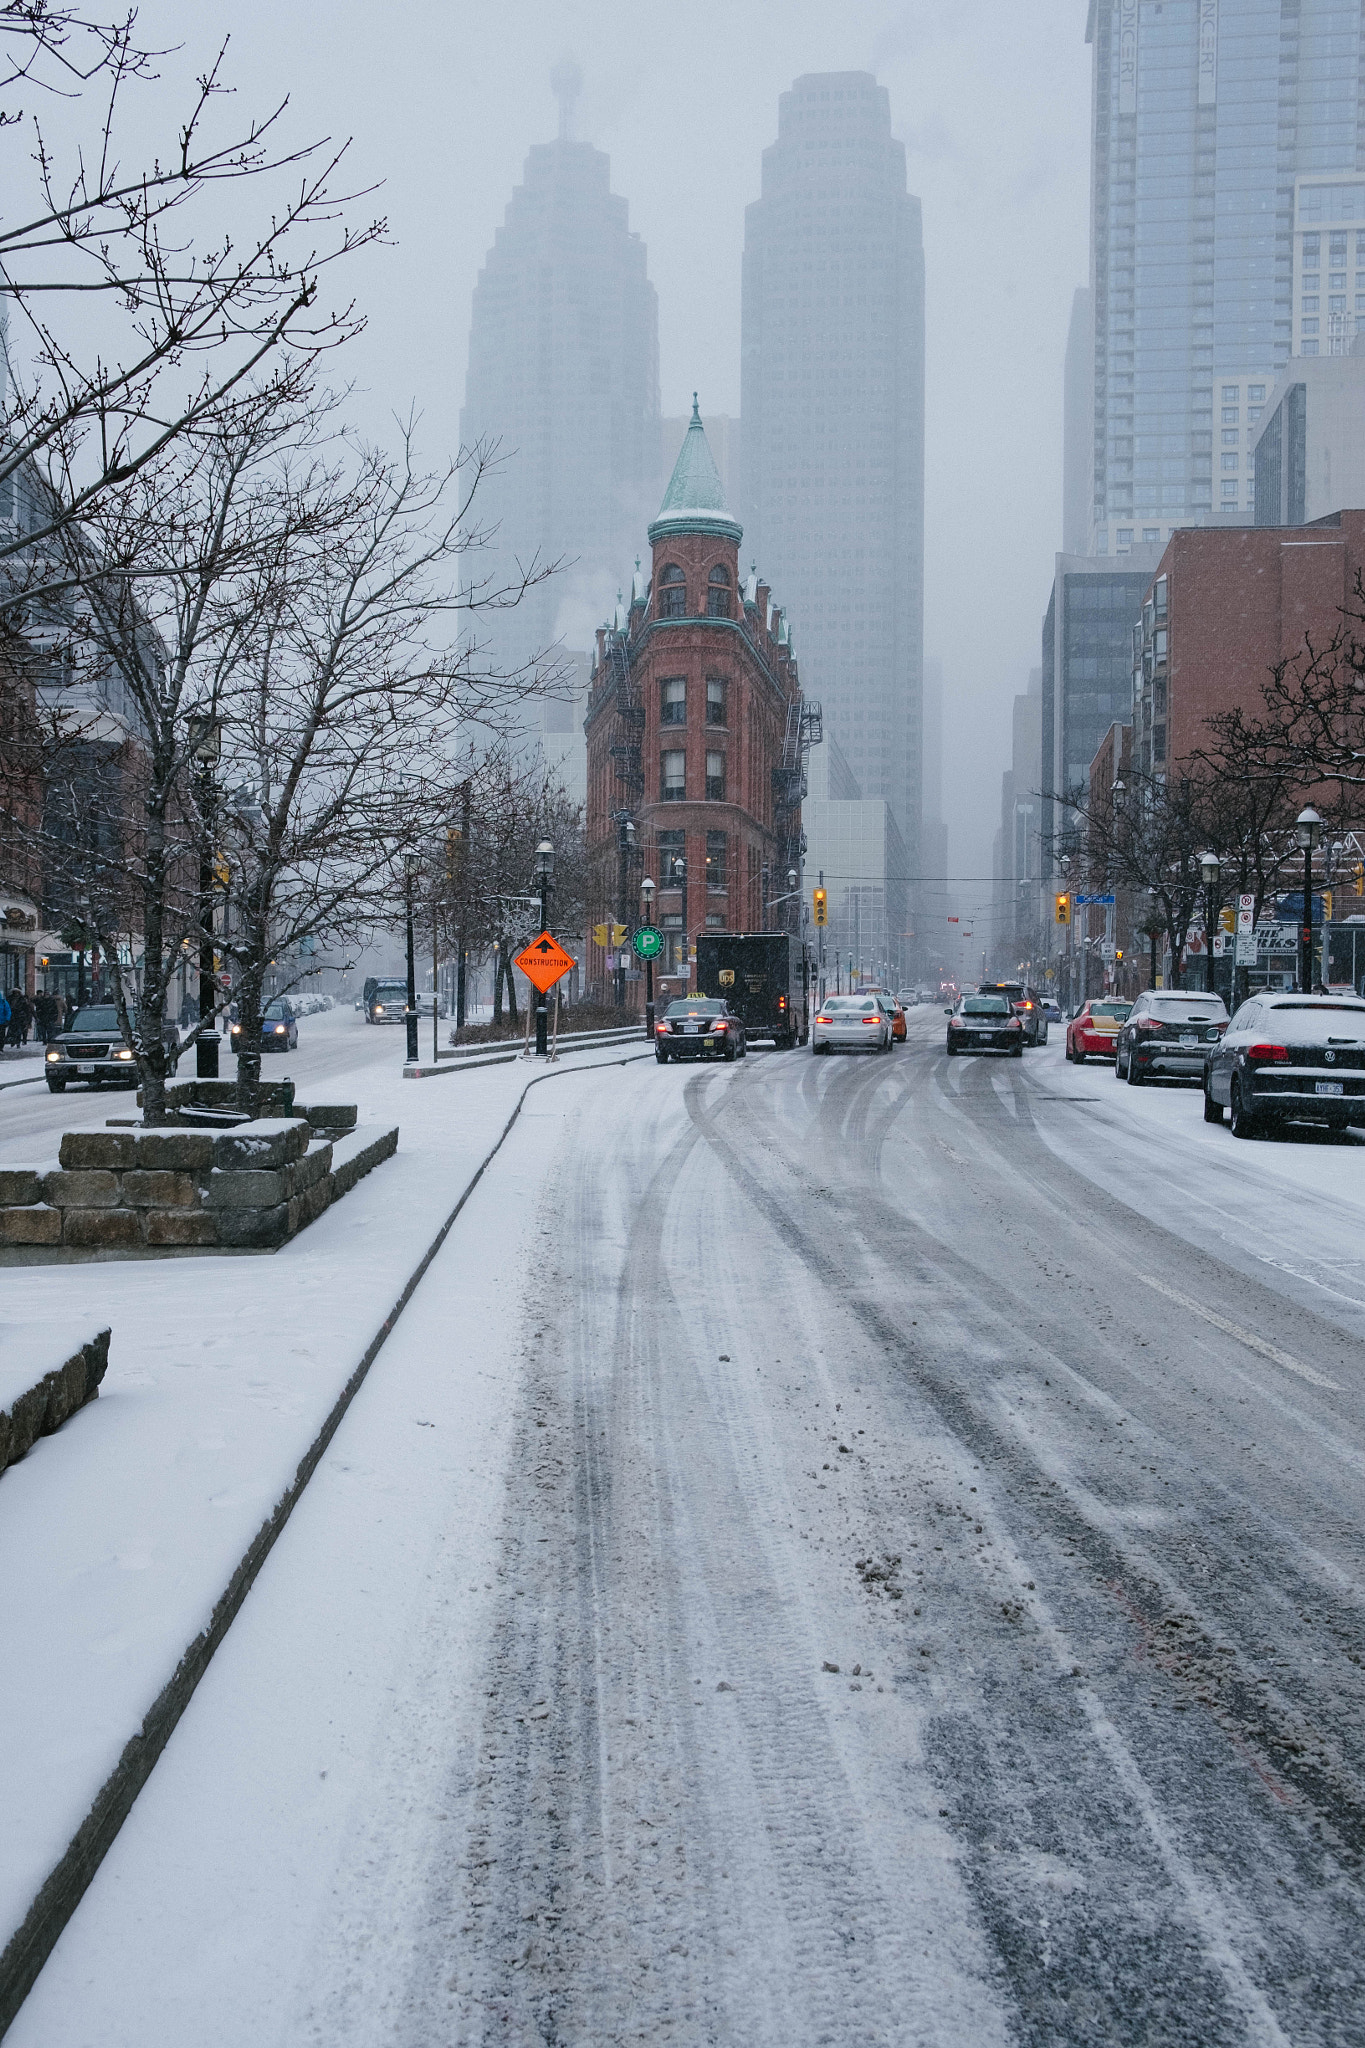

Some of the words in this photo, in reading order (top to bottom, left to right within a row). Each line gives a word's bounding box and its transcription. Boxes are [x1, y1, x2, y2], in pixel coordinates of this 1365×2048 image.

[643, 935, 655, 947] P
[1225, 936, 1297, 948] WRKS
[520, 958, 568, 966] CONSTRUCTION
[719, 974, 733, 984] ups
